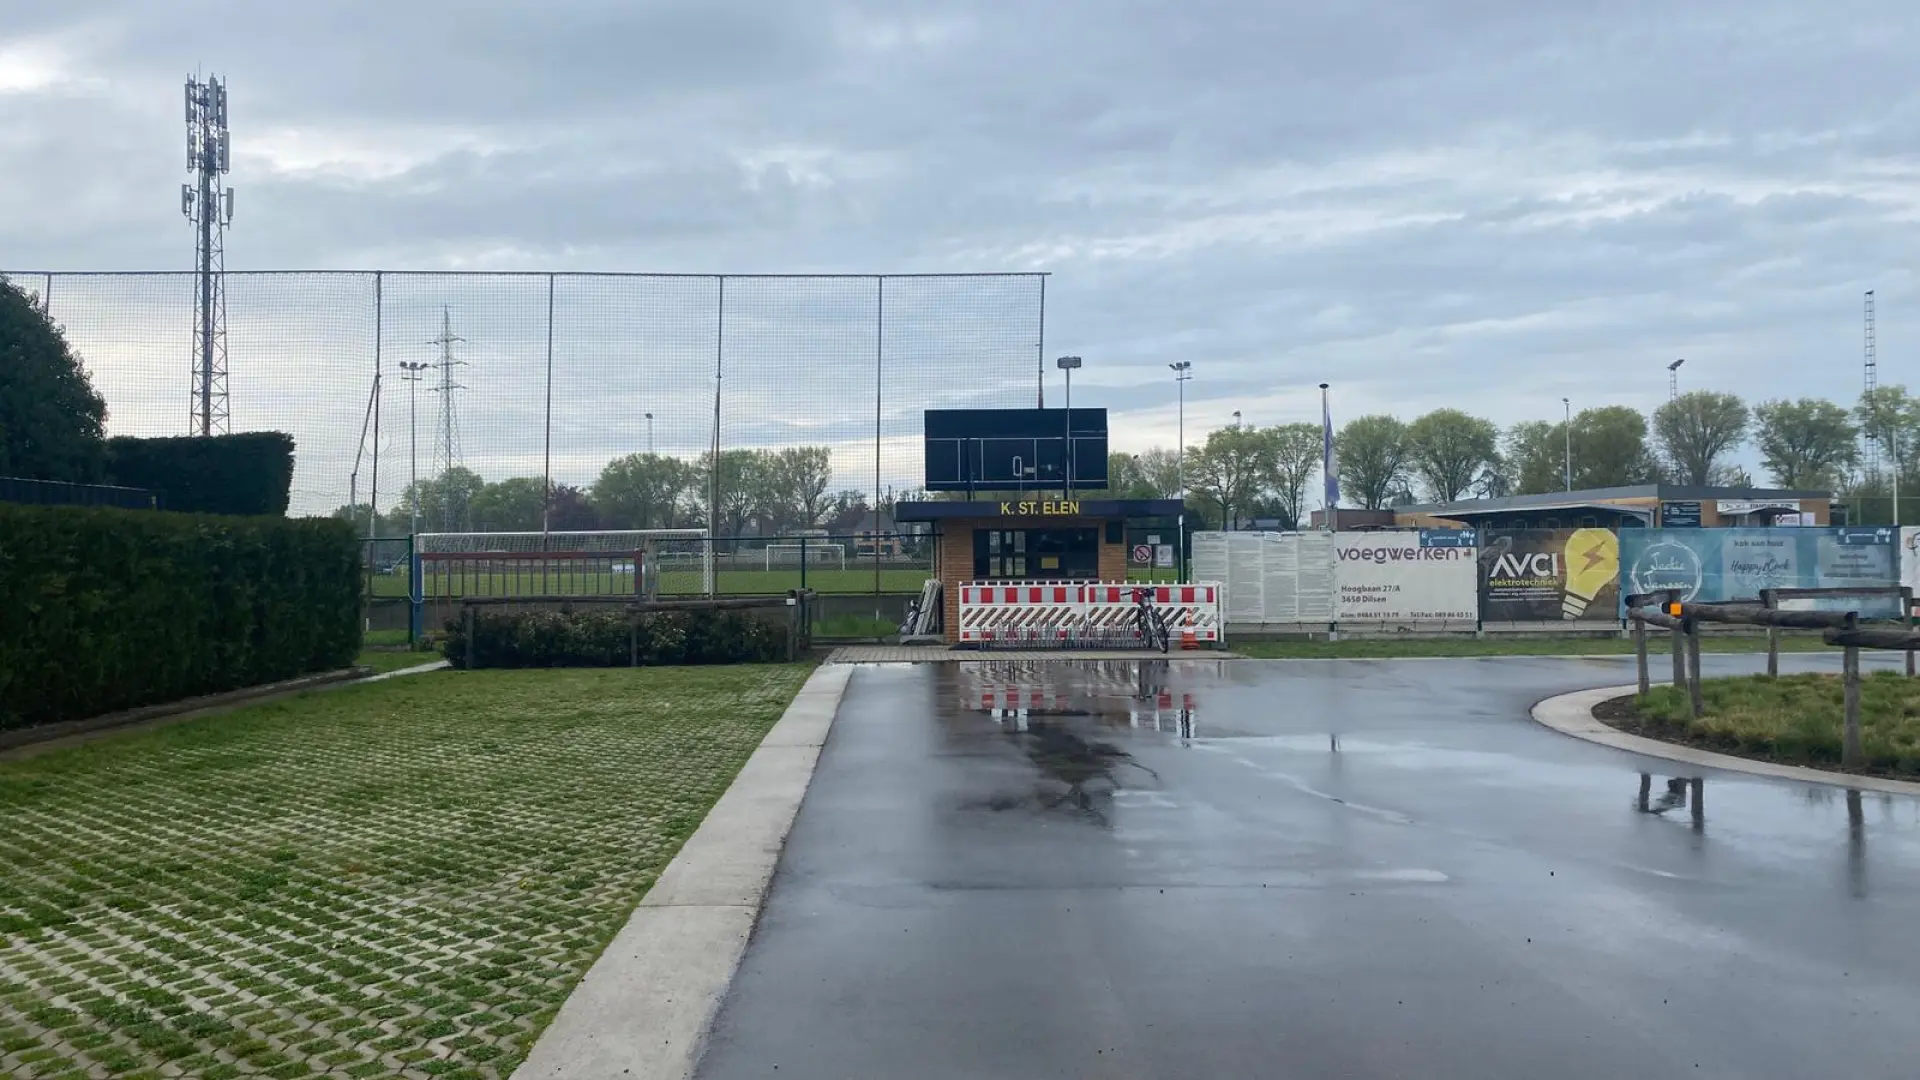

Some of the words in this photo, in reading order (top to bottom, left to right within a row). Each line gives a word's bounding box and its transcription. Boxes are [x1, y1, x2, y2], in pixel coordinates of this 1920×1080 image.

[1000, 501, 1014, 515] K.
[1018, 501, 1039, 515] ST.
[1043, 501, 1080, 515] ELEN
[1336, 546, 1459, 564] voegwerken
[1489, 552, 1558, 578] AVCI
[1341, 584, 1381, 594] Hoogbaan
[1382, 584, 1401, 593] 27/A
[1341, 595, 1361, 603] 3650
[1362, 595, 1387, 603] Dilsen
